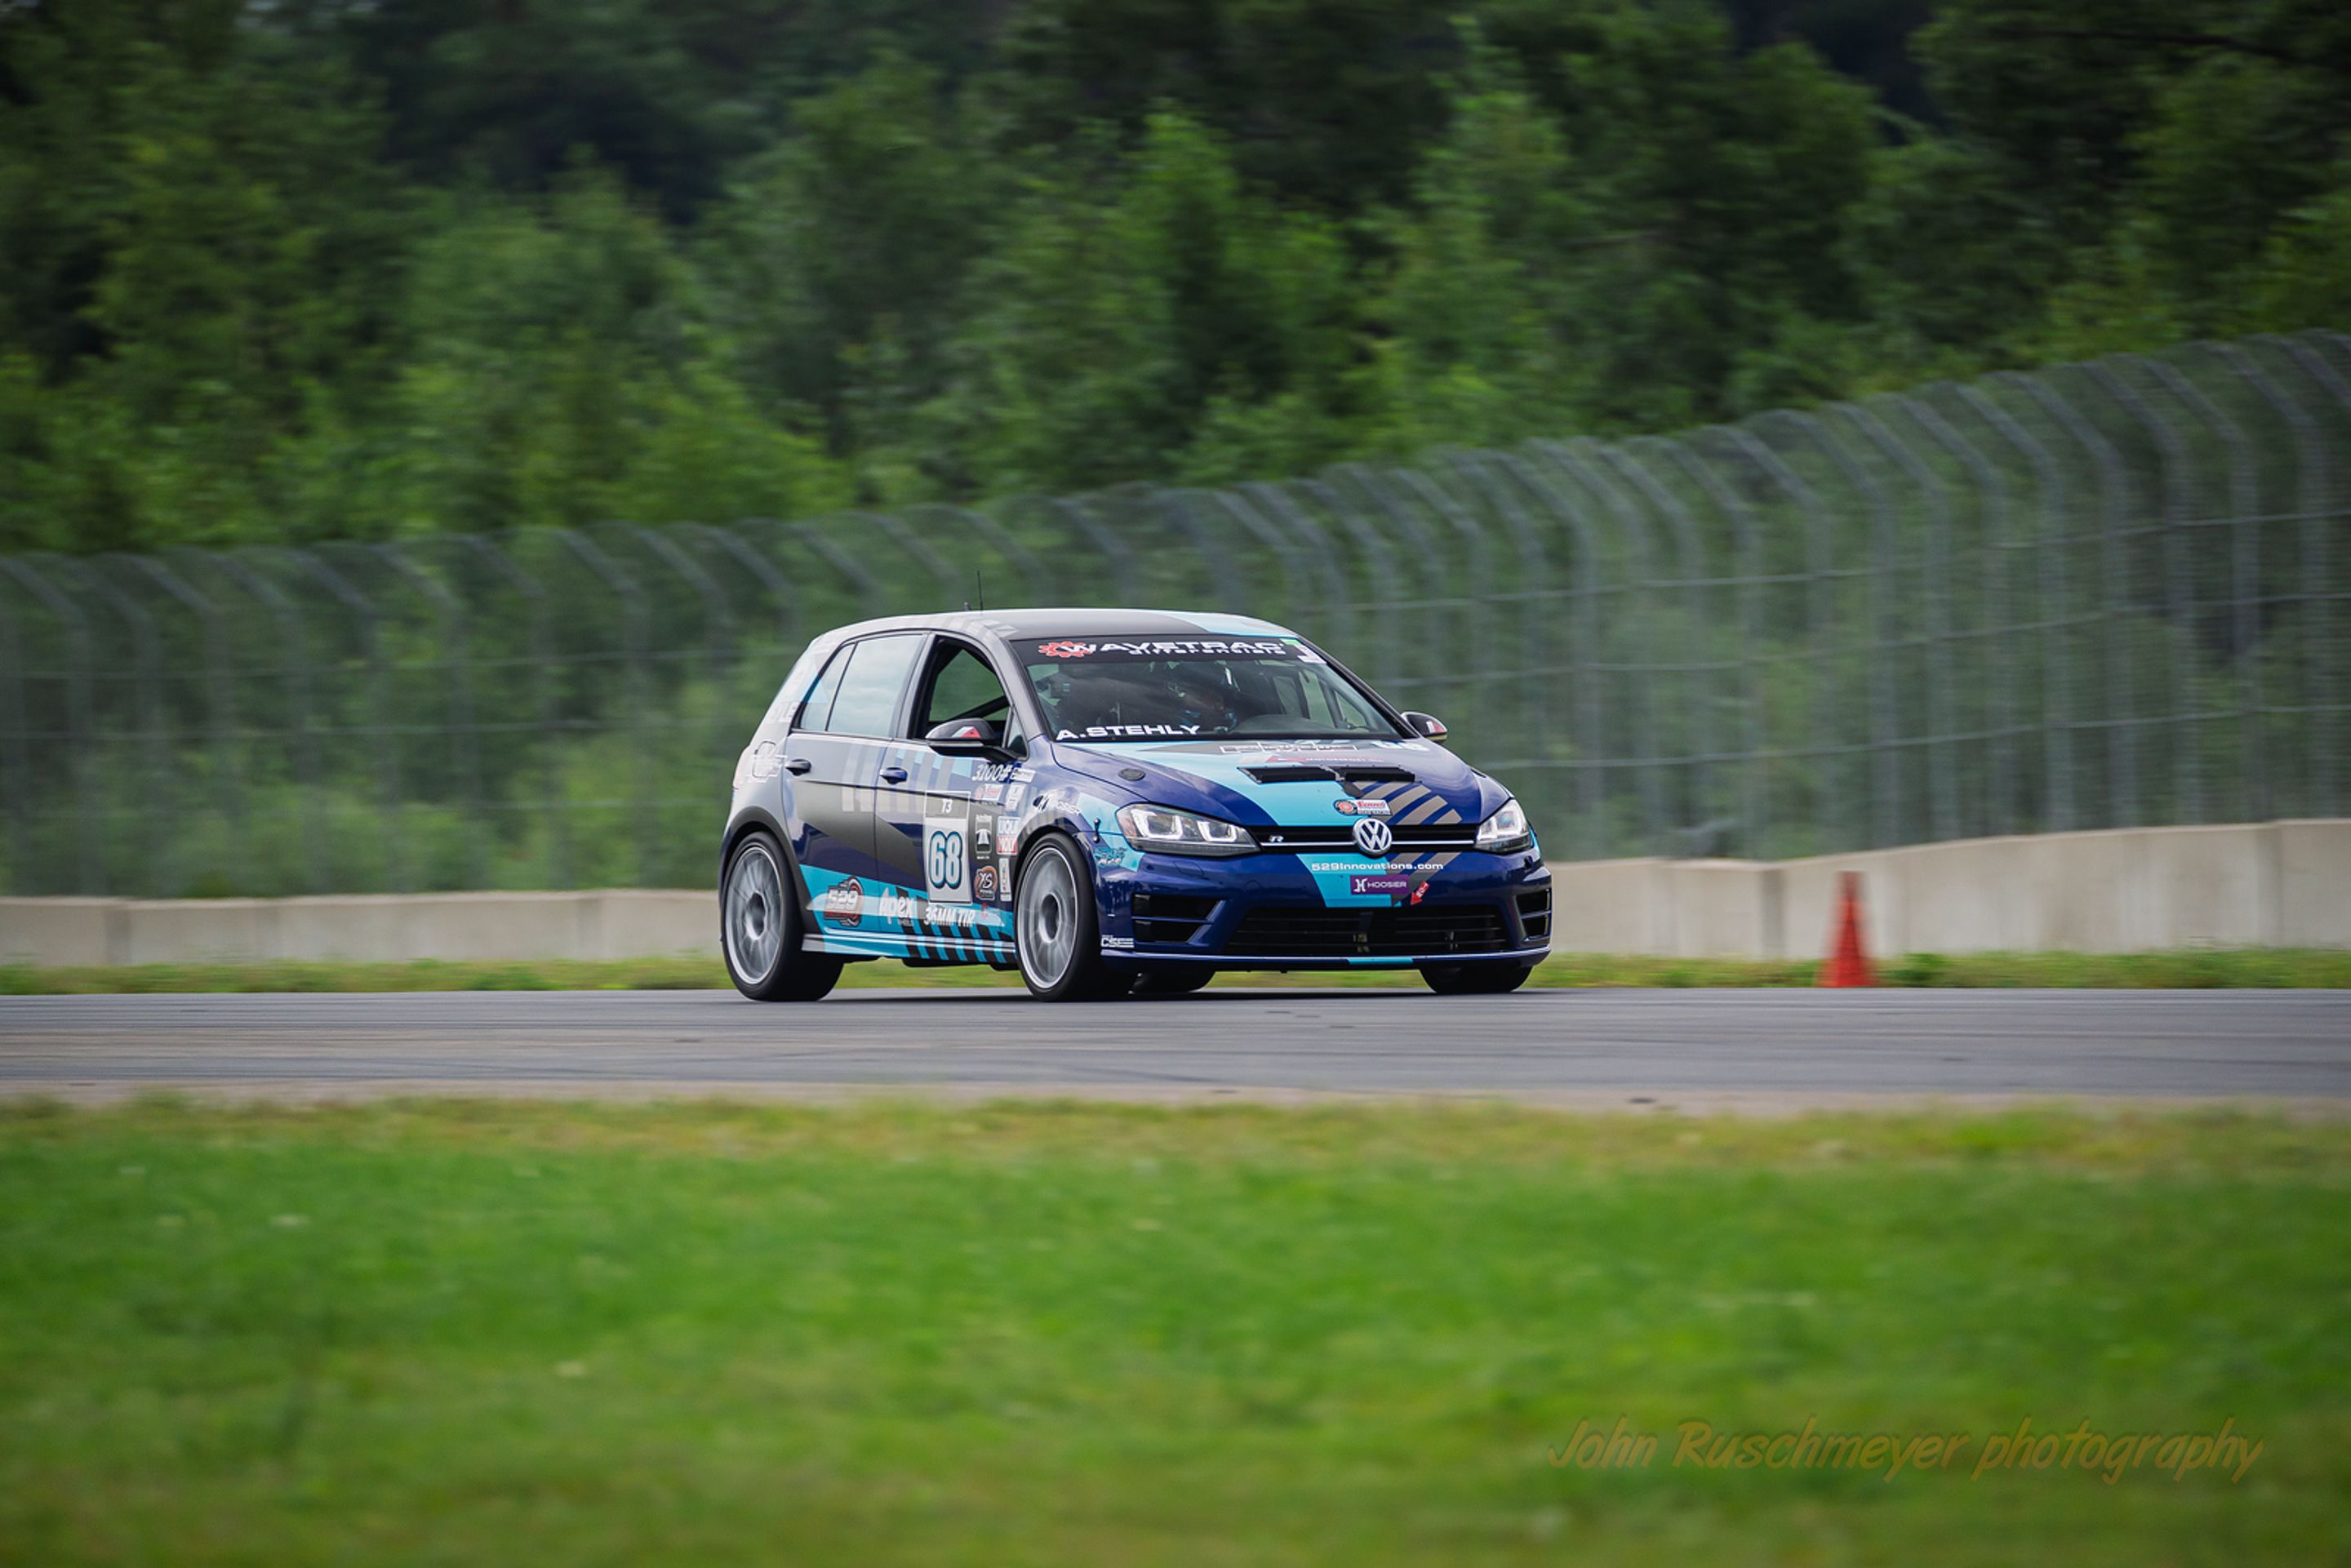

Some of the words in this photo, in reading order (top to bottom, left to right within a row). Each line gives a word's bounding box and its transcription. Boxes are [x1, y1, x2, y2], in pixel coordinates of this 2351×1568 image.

[1056, 724, 1200, 740] A.STEHLY
[972, 764, 1013, 781] 3100#
[941, 798, 953, 813] T3
[929, 830, 963, 890] 68
[1367, 881, 1407, 889] HOOSIER
[828, 890, 858, 910] 529
